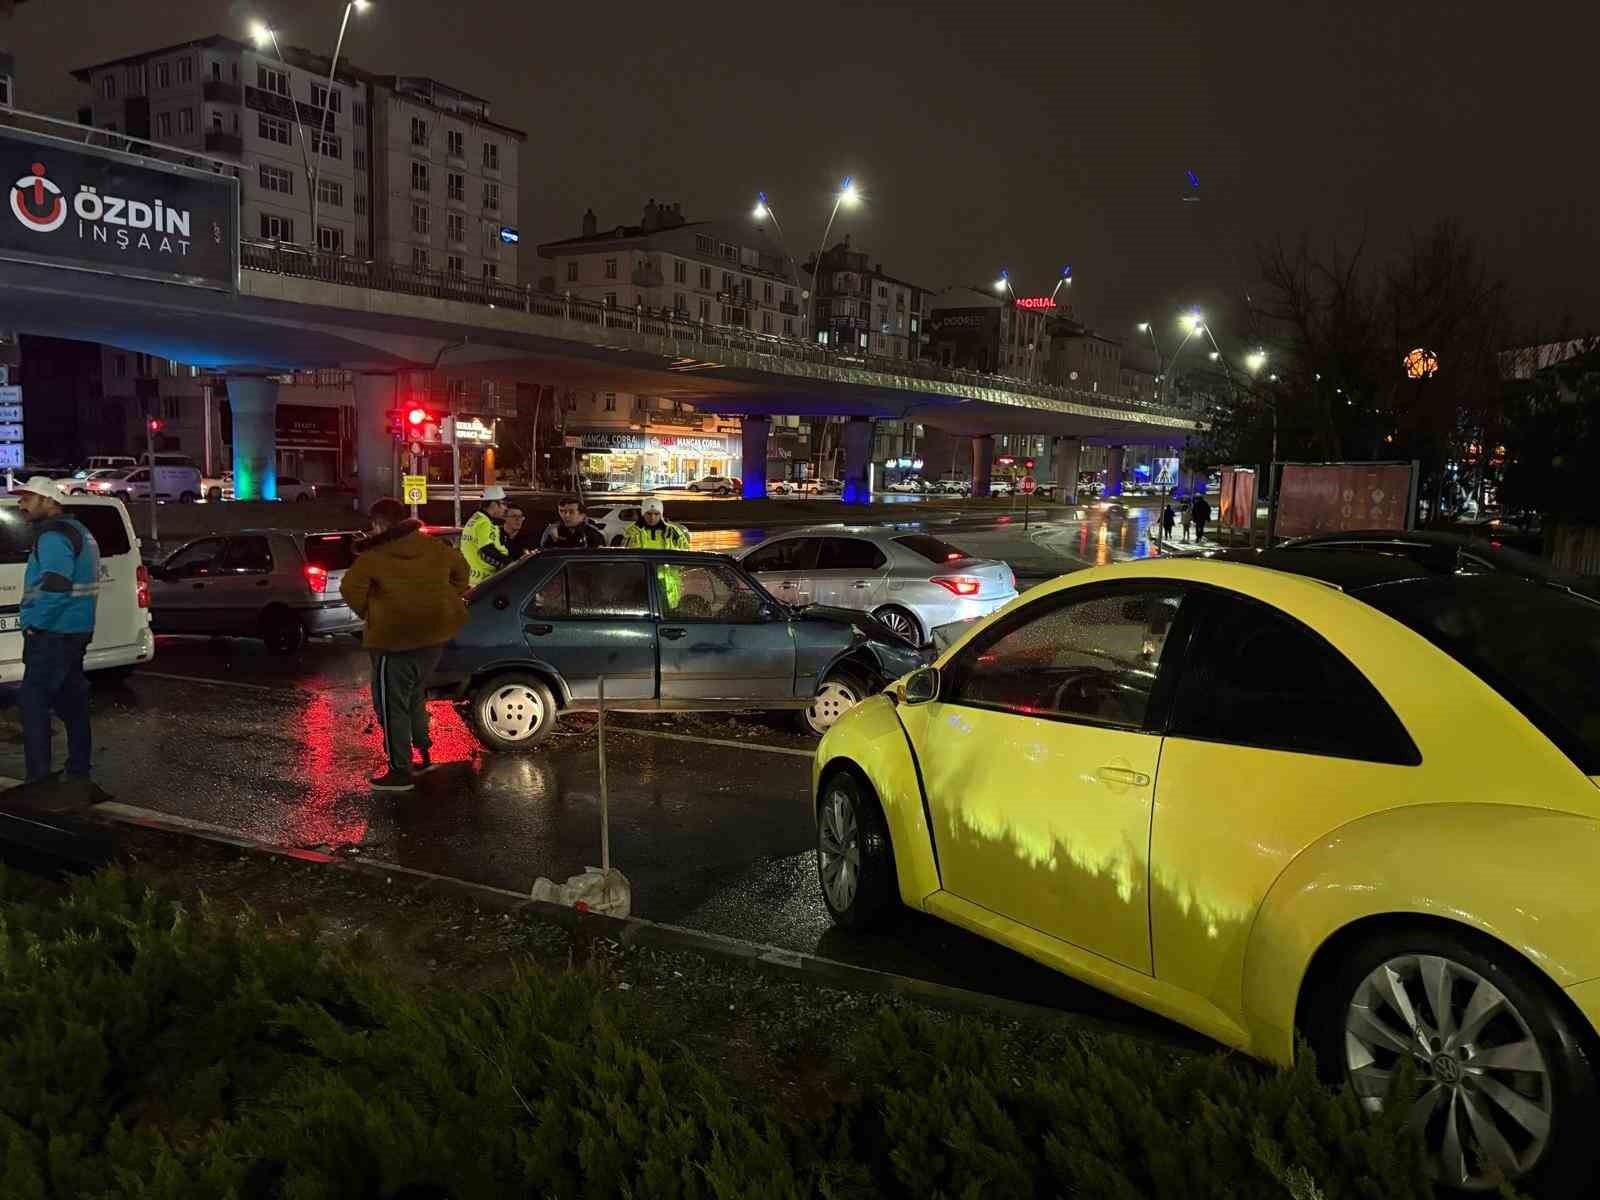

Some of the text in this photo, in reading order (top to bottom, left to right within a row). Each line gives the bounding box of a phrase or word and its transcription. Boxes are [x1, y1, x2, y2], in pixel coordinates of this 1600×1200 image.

[74, 185, 190, 237] ÖZDİN
[79, 220, 191, 256] İNŞAAT
[1019, 480, 1035, 489] DUR
